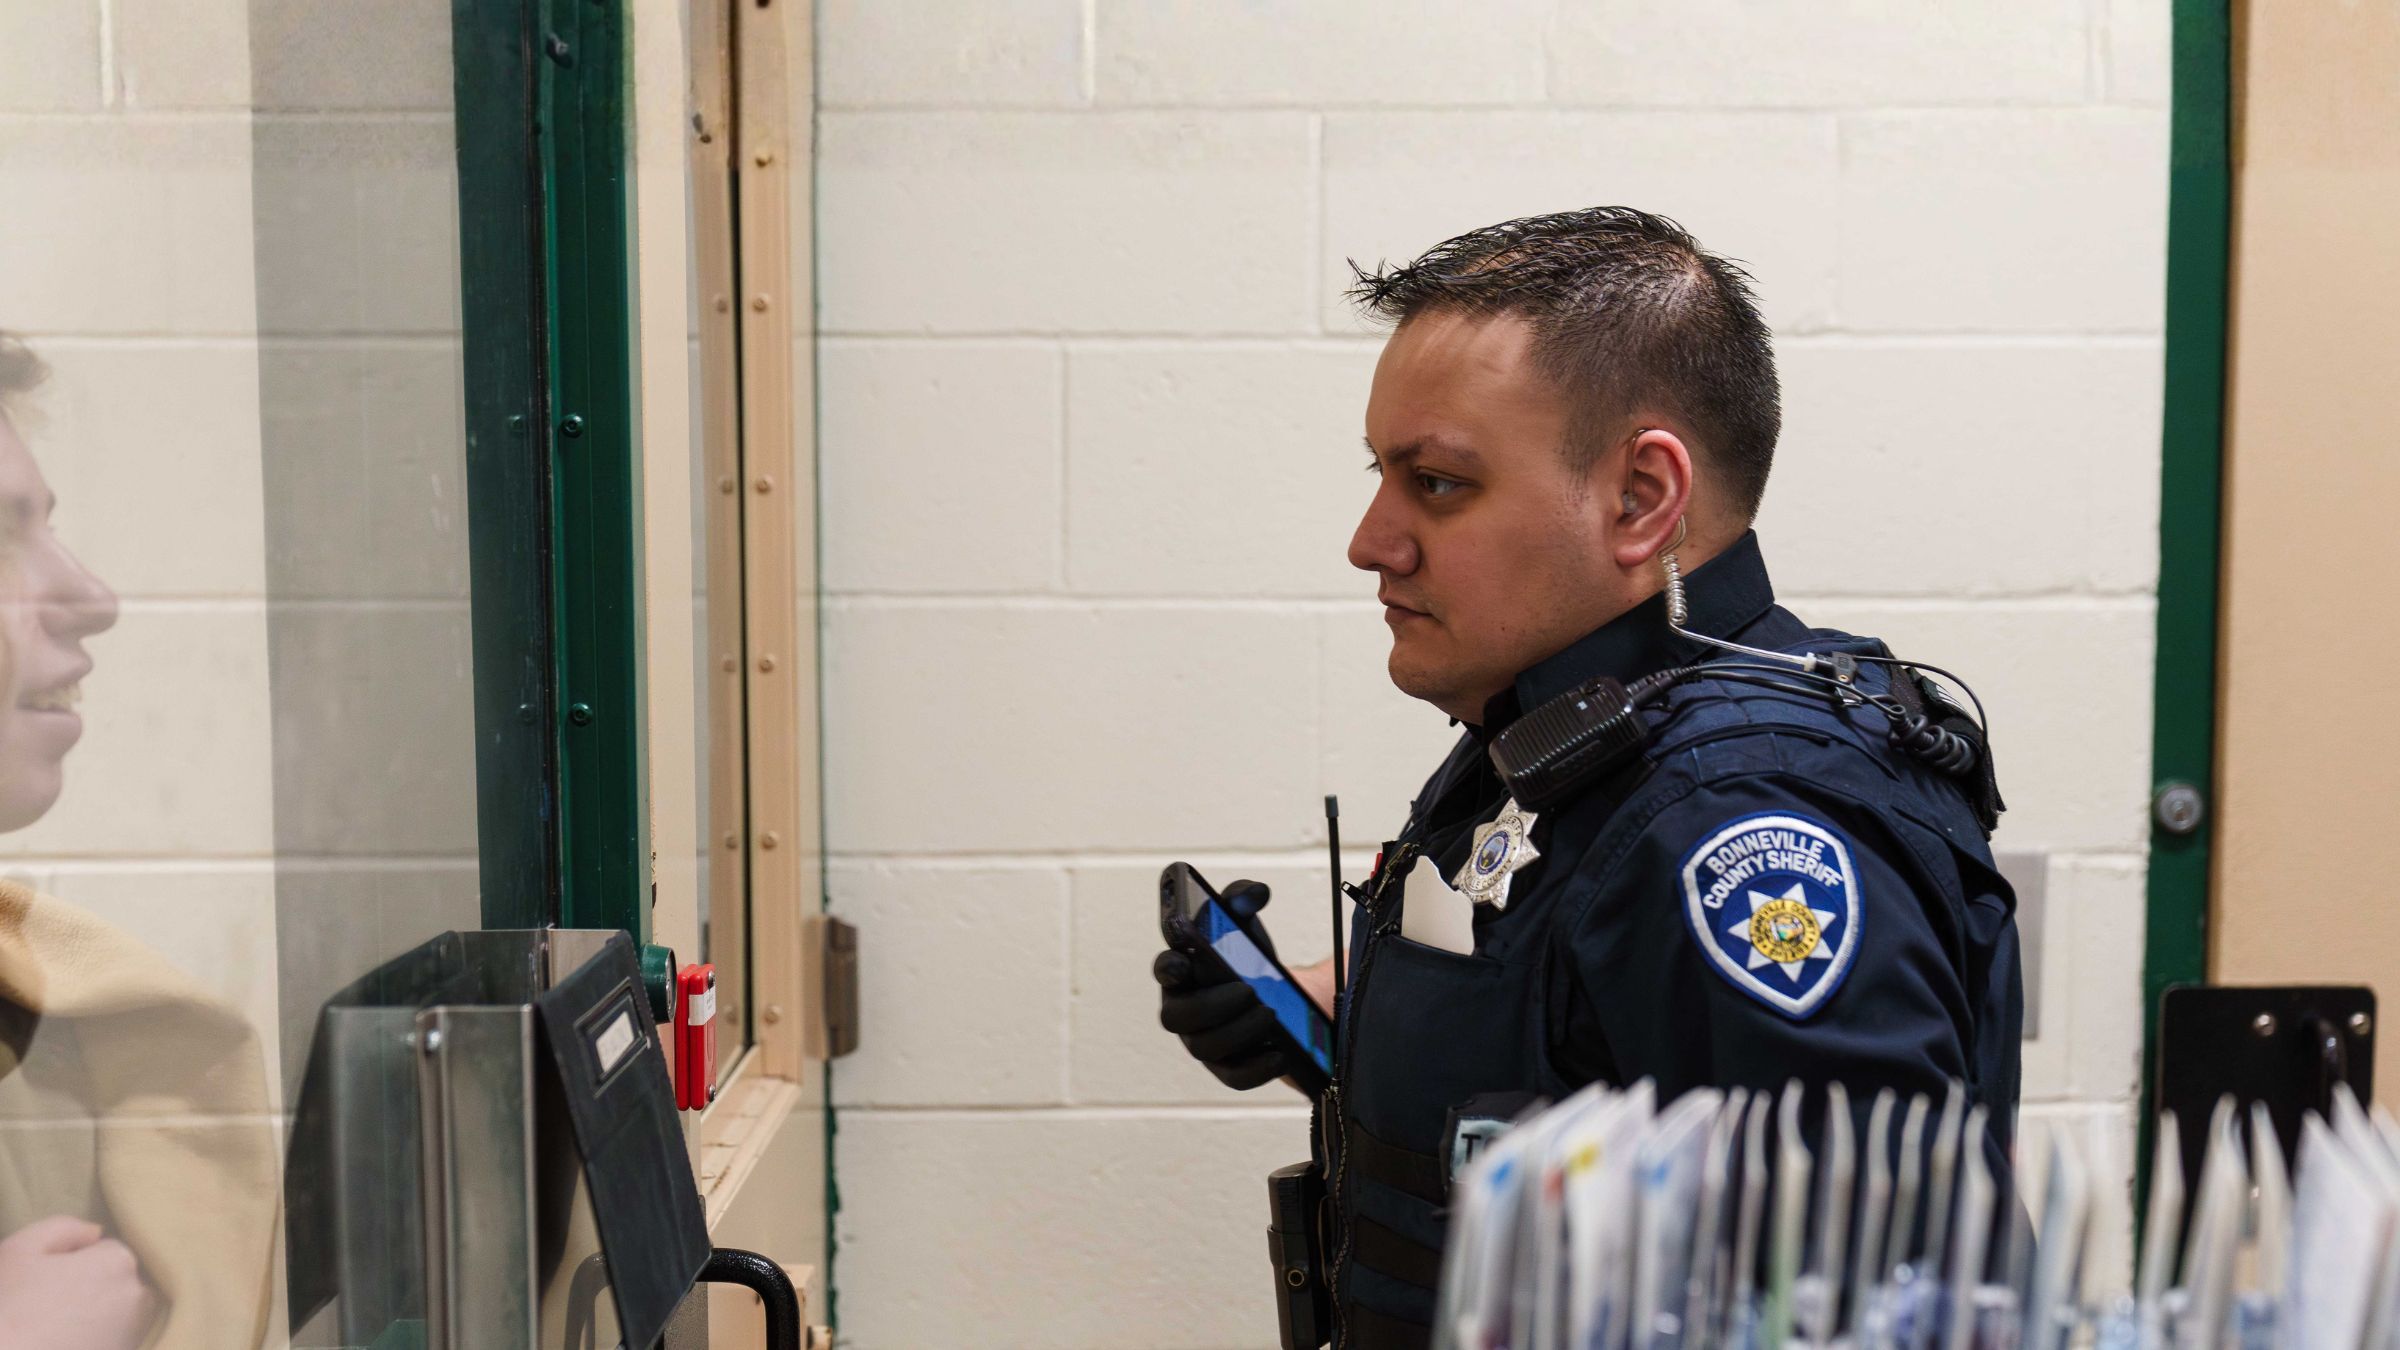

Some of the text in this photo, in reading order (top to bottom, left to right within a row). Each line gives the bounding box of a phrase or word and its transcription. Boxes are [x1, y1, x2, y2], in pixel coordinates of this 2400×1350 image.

[1705, 830, 1825, 876] BONNEVILLE
[1702, 850, 1844, 910] COUNTY SHERIFF
